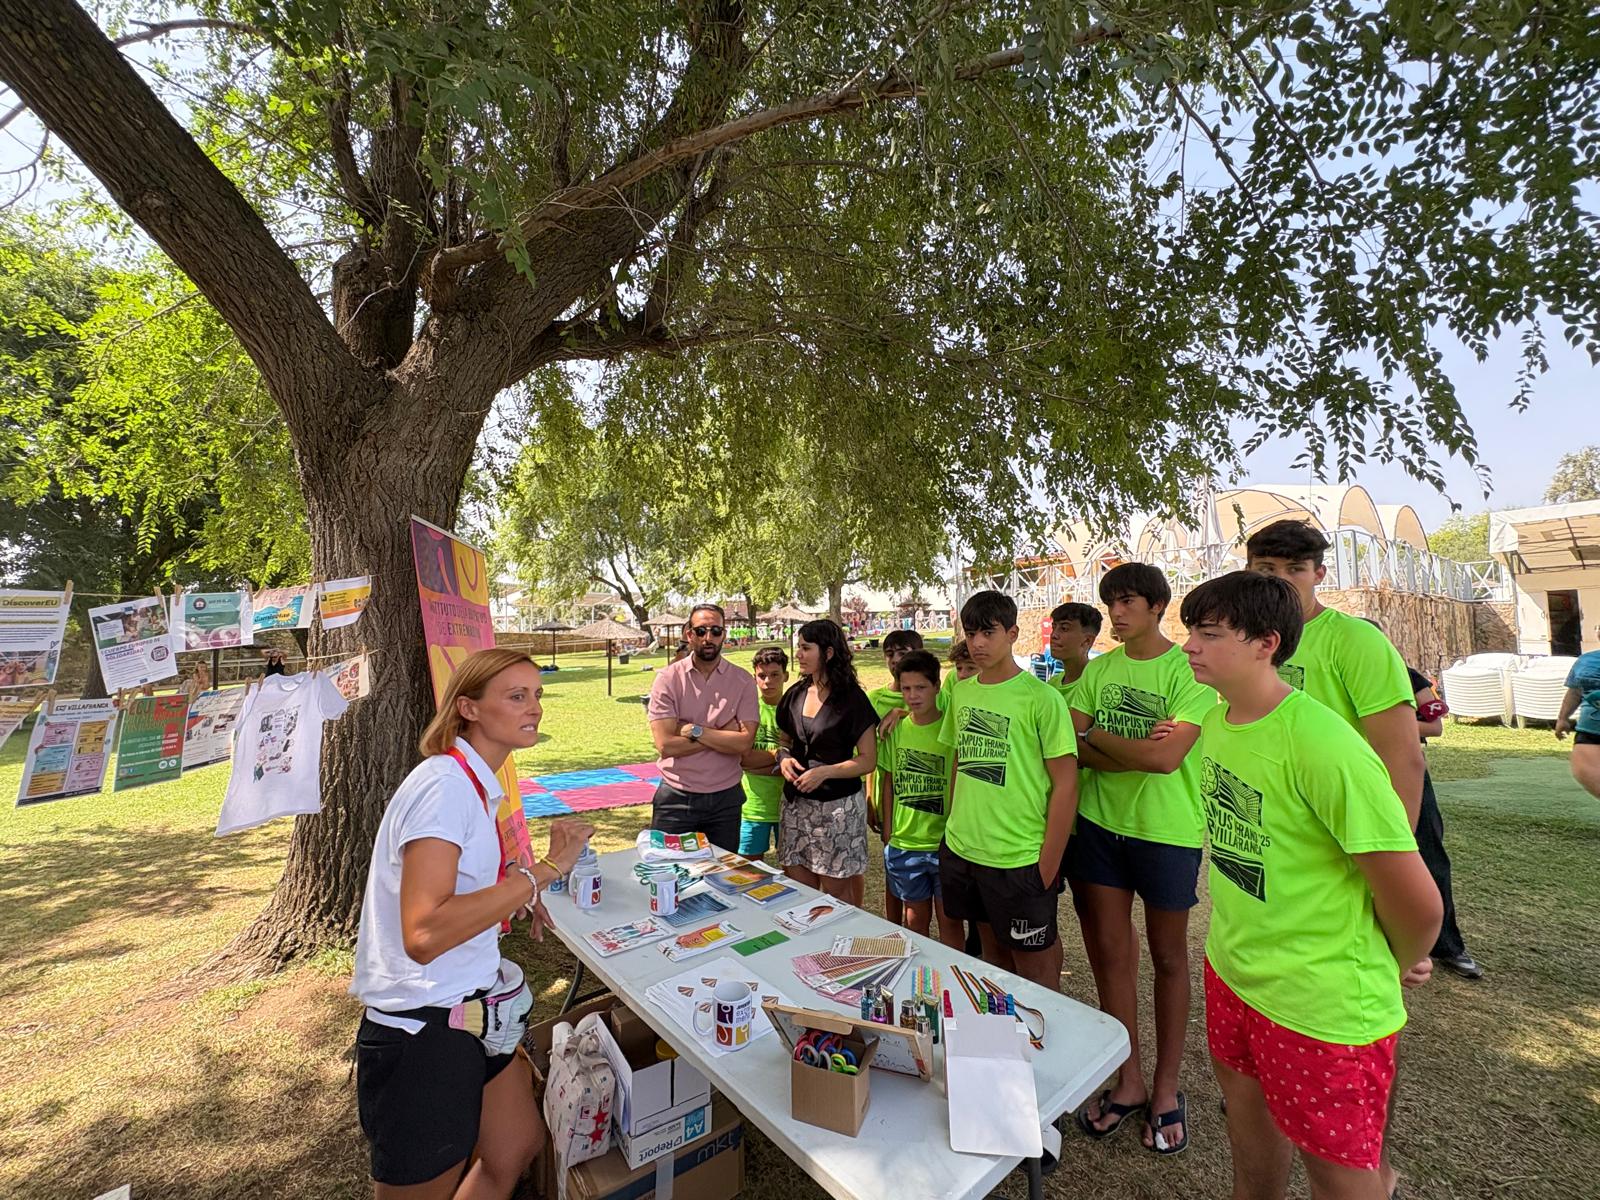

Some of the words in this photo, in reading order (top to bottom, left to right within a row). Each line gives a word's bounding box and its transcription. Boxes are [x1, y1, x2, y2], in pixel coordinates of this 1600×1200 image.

[2, 599, 58, 607] DiscoverEU
[67, 702, 109, 711] VILLAFRANCA
[1095, 709, 1141, 728] CAMPUS
[1142, 719, 1157, 730] VER
[685, 1119, 704, 1138] A4
[639, 1139, 673, 1162] Report
